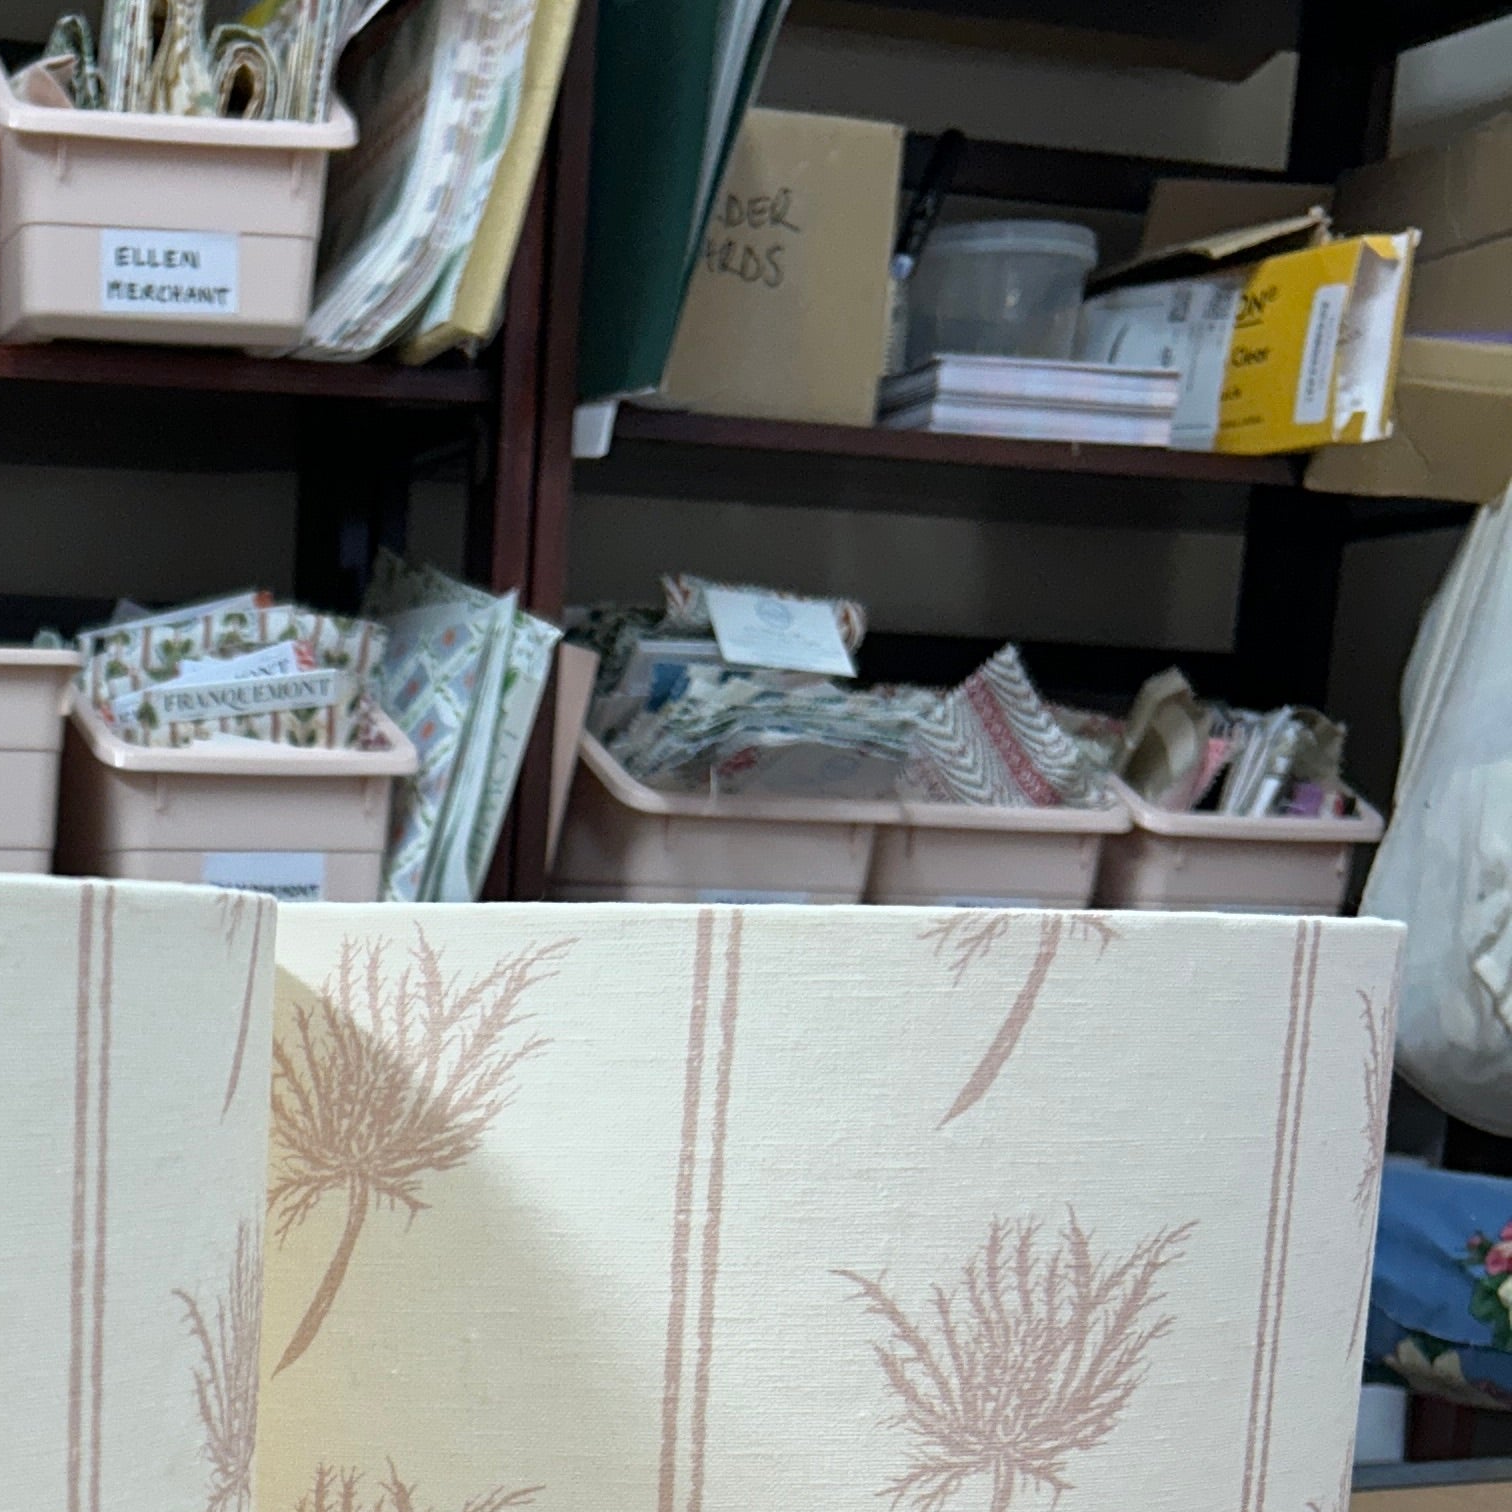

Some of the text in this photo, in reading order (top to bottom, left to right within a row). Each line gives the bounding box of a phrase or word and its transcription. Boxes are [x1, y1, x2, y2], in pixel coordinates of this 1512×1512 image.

[718, 186, 800, 233] DER
[114, 245, 201, 269] ELLEN
[106, 279, 231, 305] MERCHANT
[162, 678, 332, 713] FRANQUEMONT
